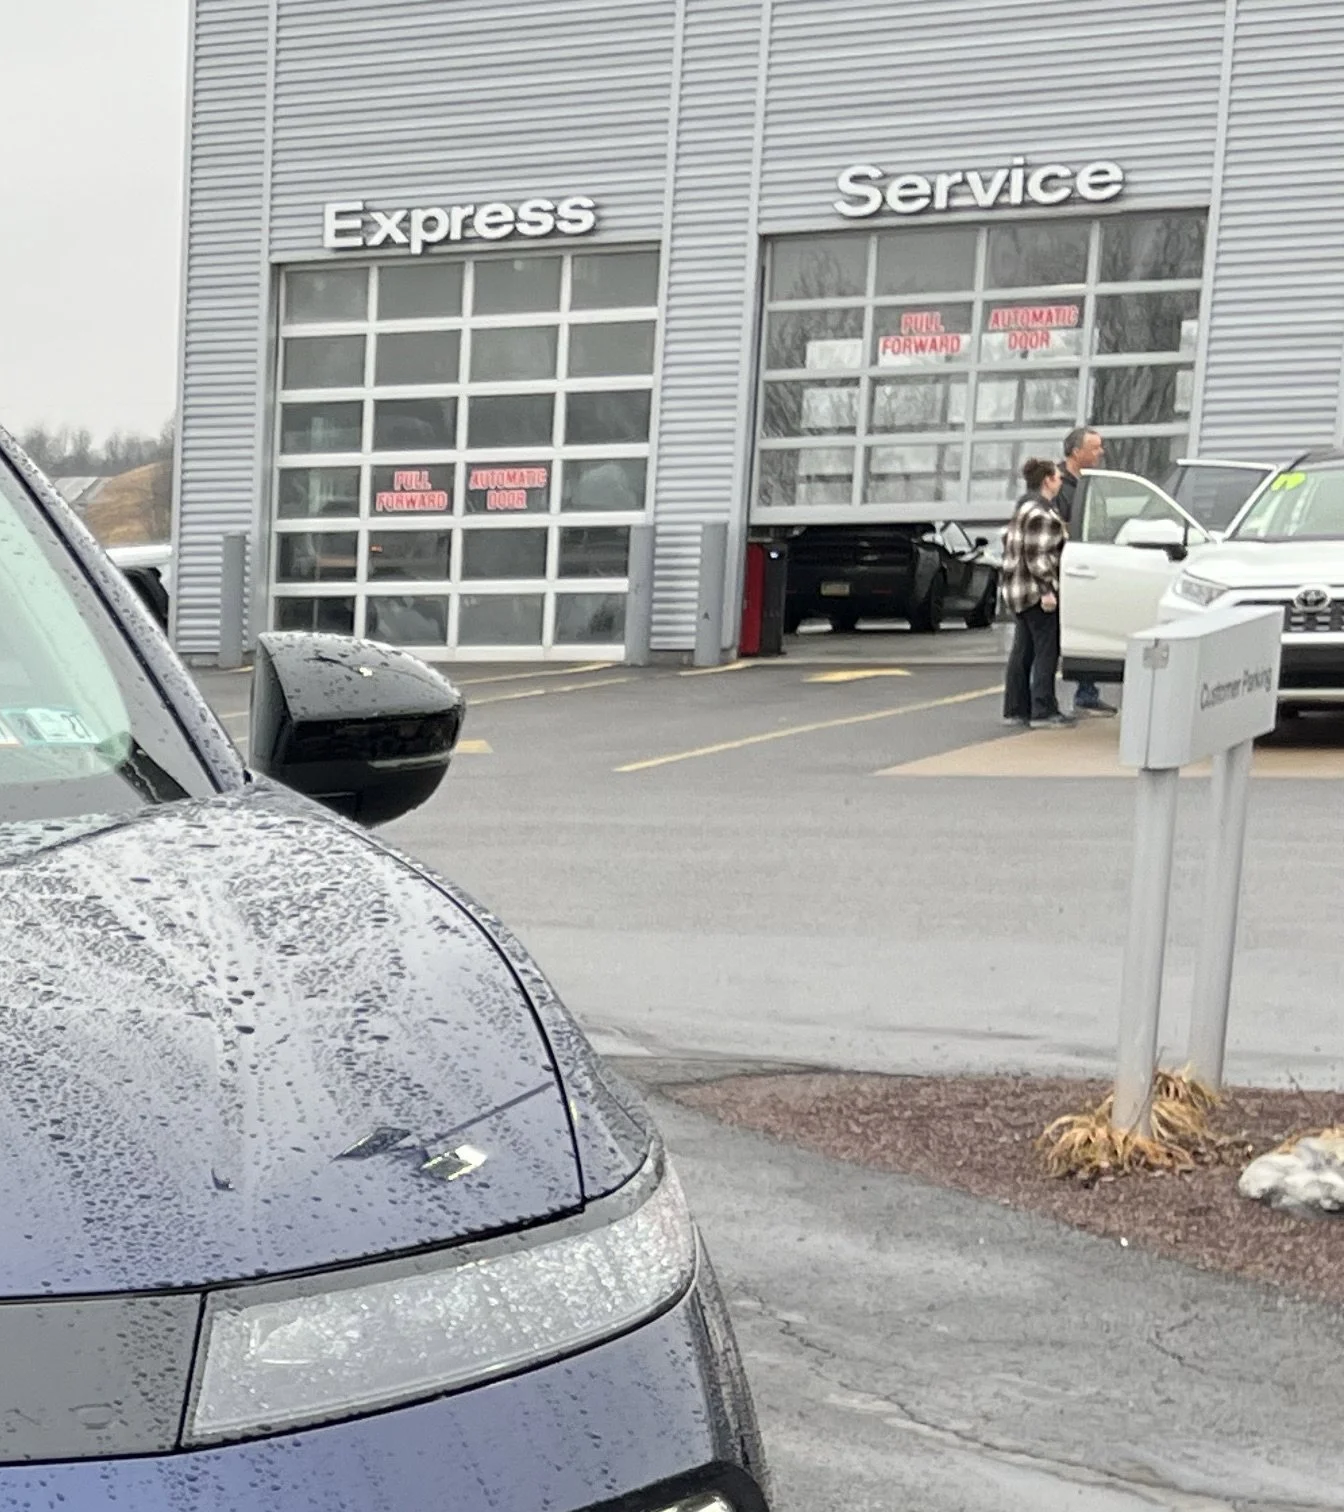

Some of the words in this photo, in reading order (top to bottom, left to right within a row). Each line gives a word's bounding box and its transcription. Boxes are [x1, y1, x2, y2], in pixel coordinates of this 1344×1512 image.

[832, 156, 1124, 217] Service
[323, 196, 596, 255] Express
[901, 312, 944, 335] PULL
[989, 305, 1079, 329] AUTOMATIC
[880, 334, 961, 356] FORWARD
[1008, 331, 1050, 351] DOOR
[394, 470, 431, 490] PULL
[469, 467, 548, 490] AUTOMATIC
[376, 491, 448, 512] FORWARD
